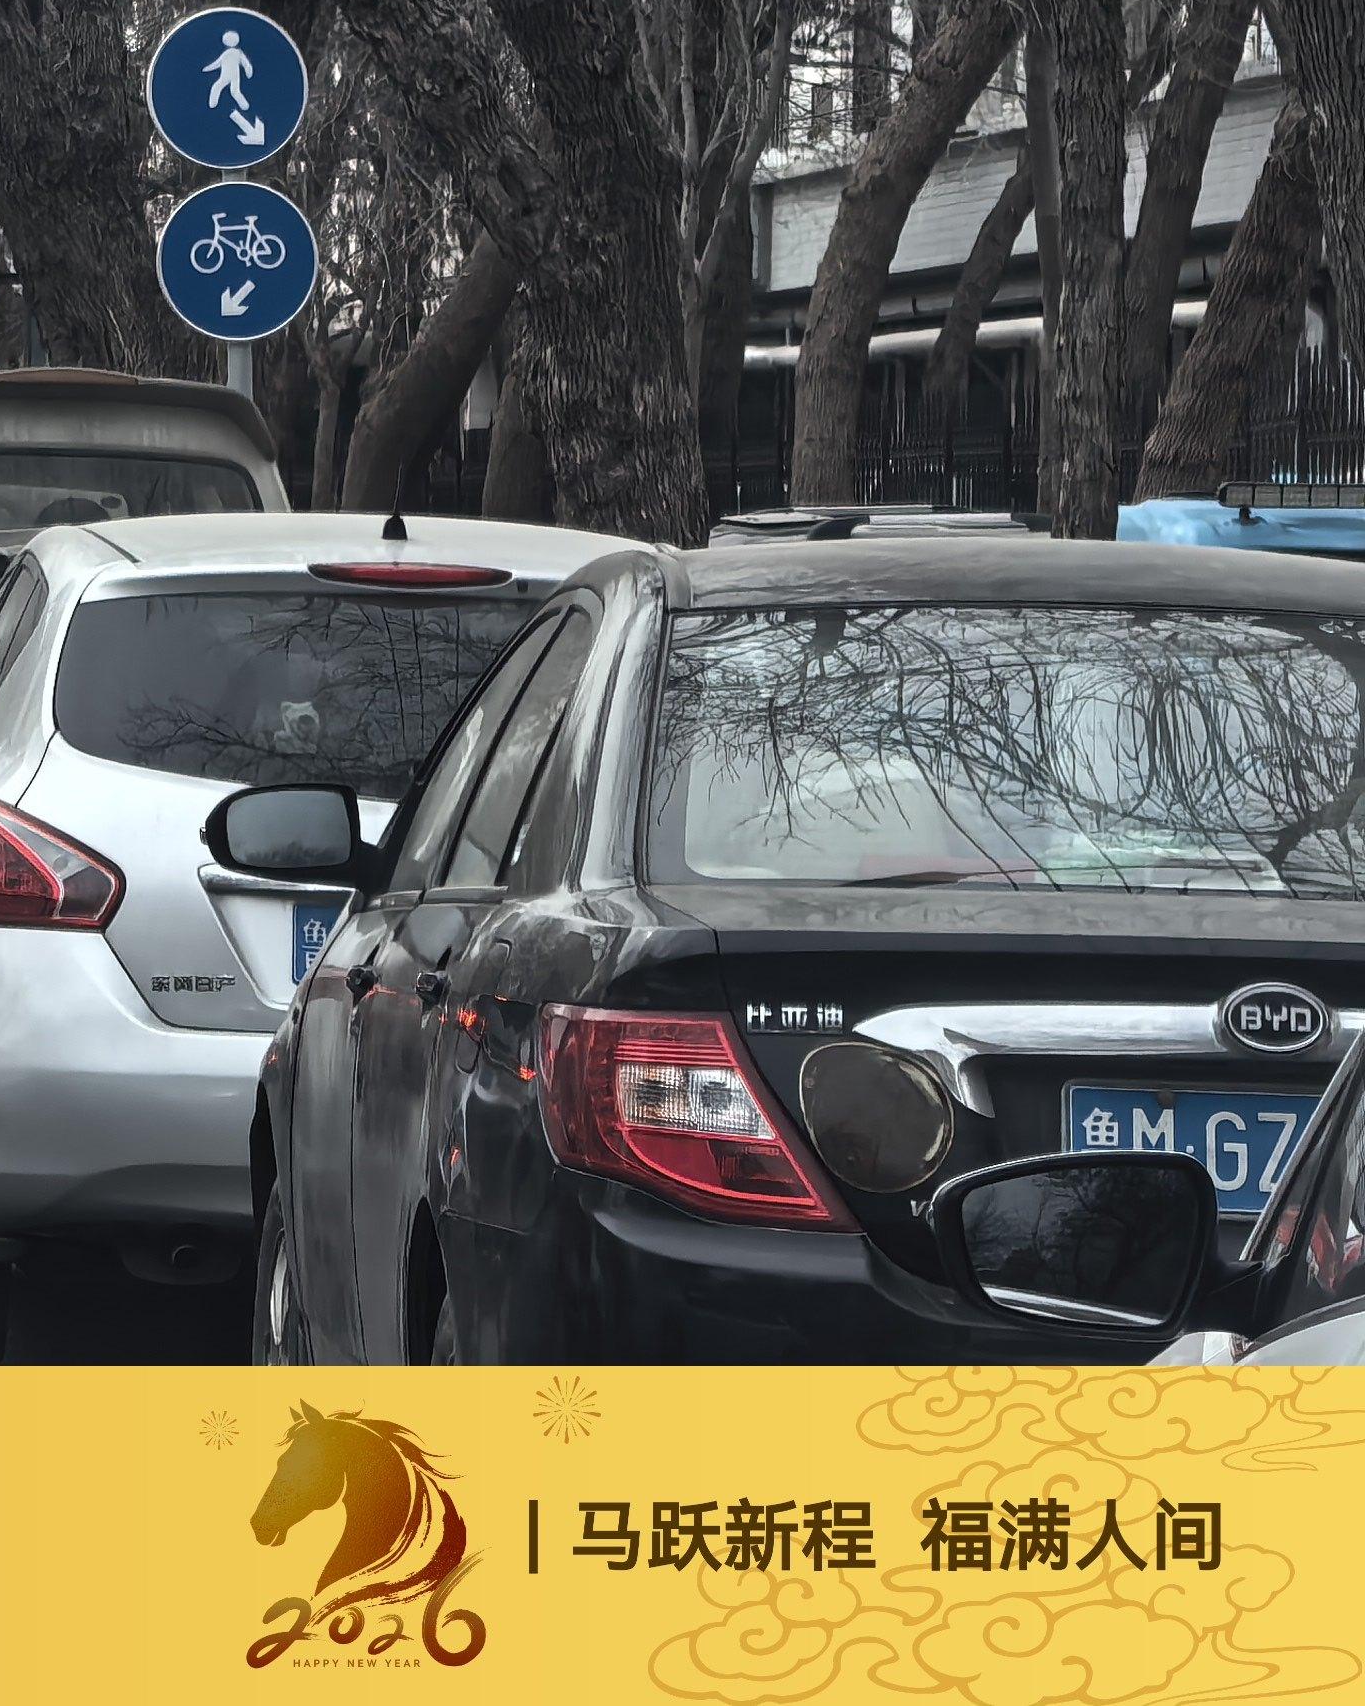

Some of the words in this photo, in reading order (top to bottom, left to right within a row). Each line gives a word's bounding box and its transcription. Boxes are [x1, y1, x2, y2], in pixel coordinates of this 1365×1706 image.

[746, 1002, 843, 1031] 比亚迪
[1240, 1005, 1312, 1032] BYD
